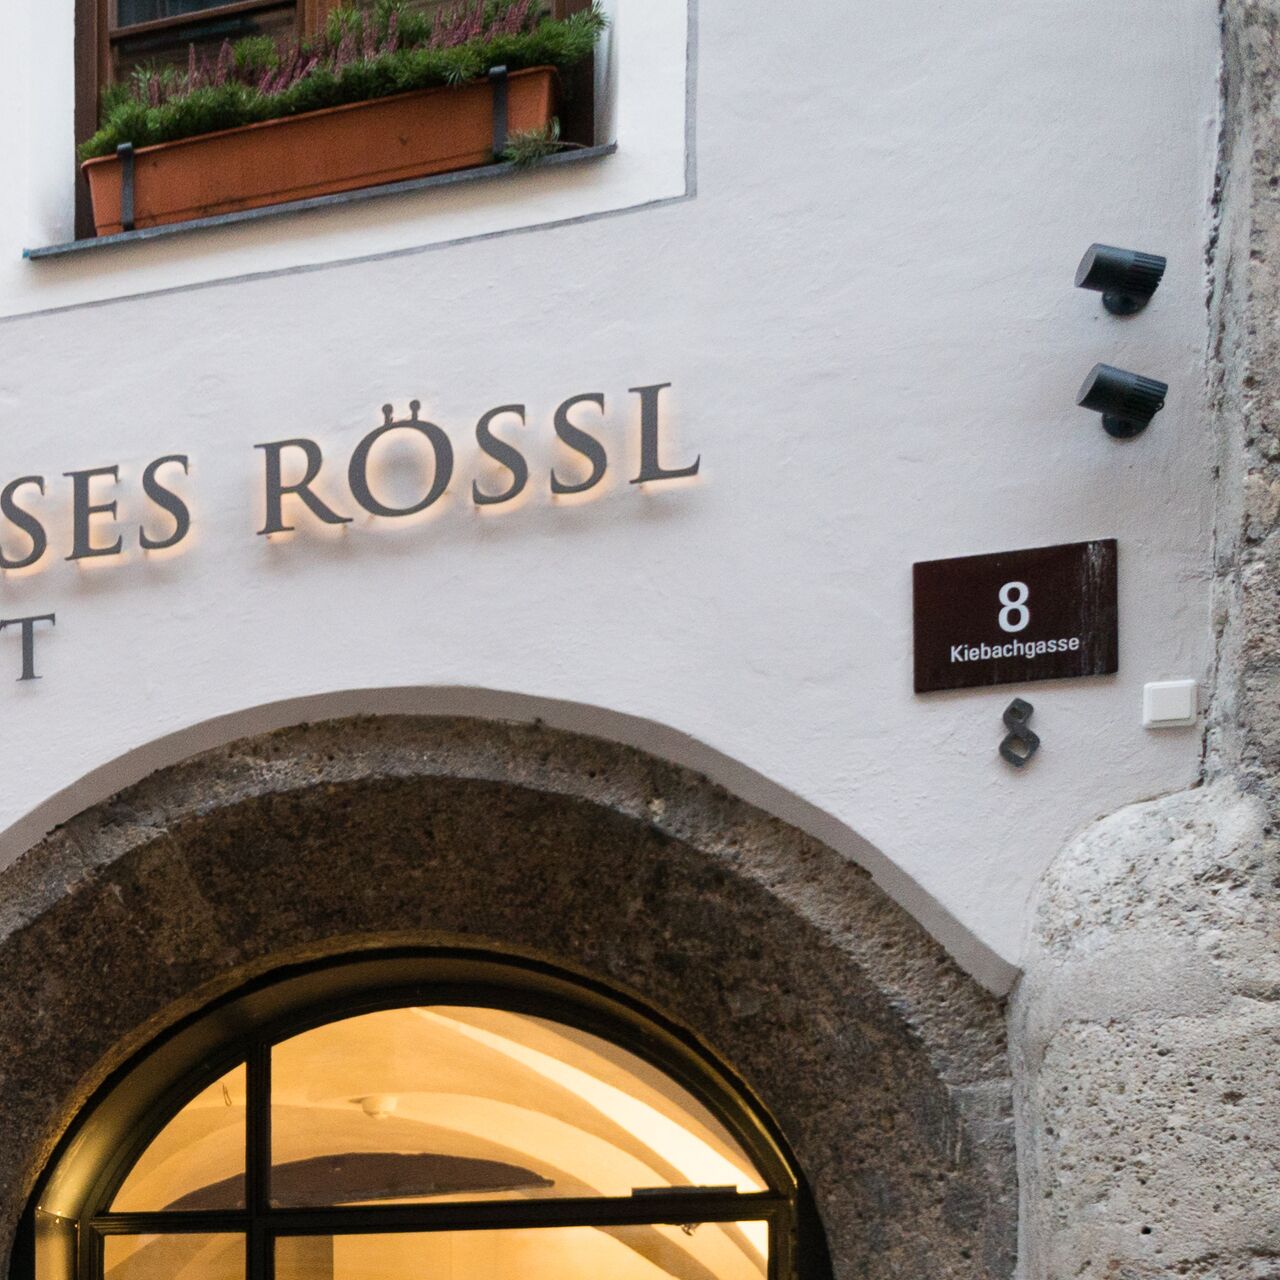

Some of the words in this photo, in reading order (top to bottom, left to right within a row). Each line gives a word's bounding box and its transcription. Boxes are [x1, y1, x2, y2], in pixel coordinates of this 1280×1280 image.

[252, 382, 701, 536] RÖSSL
[998, 581, 1030, 632] 8
[950, 636, 1080, 663] Kiebachgasse
